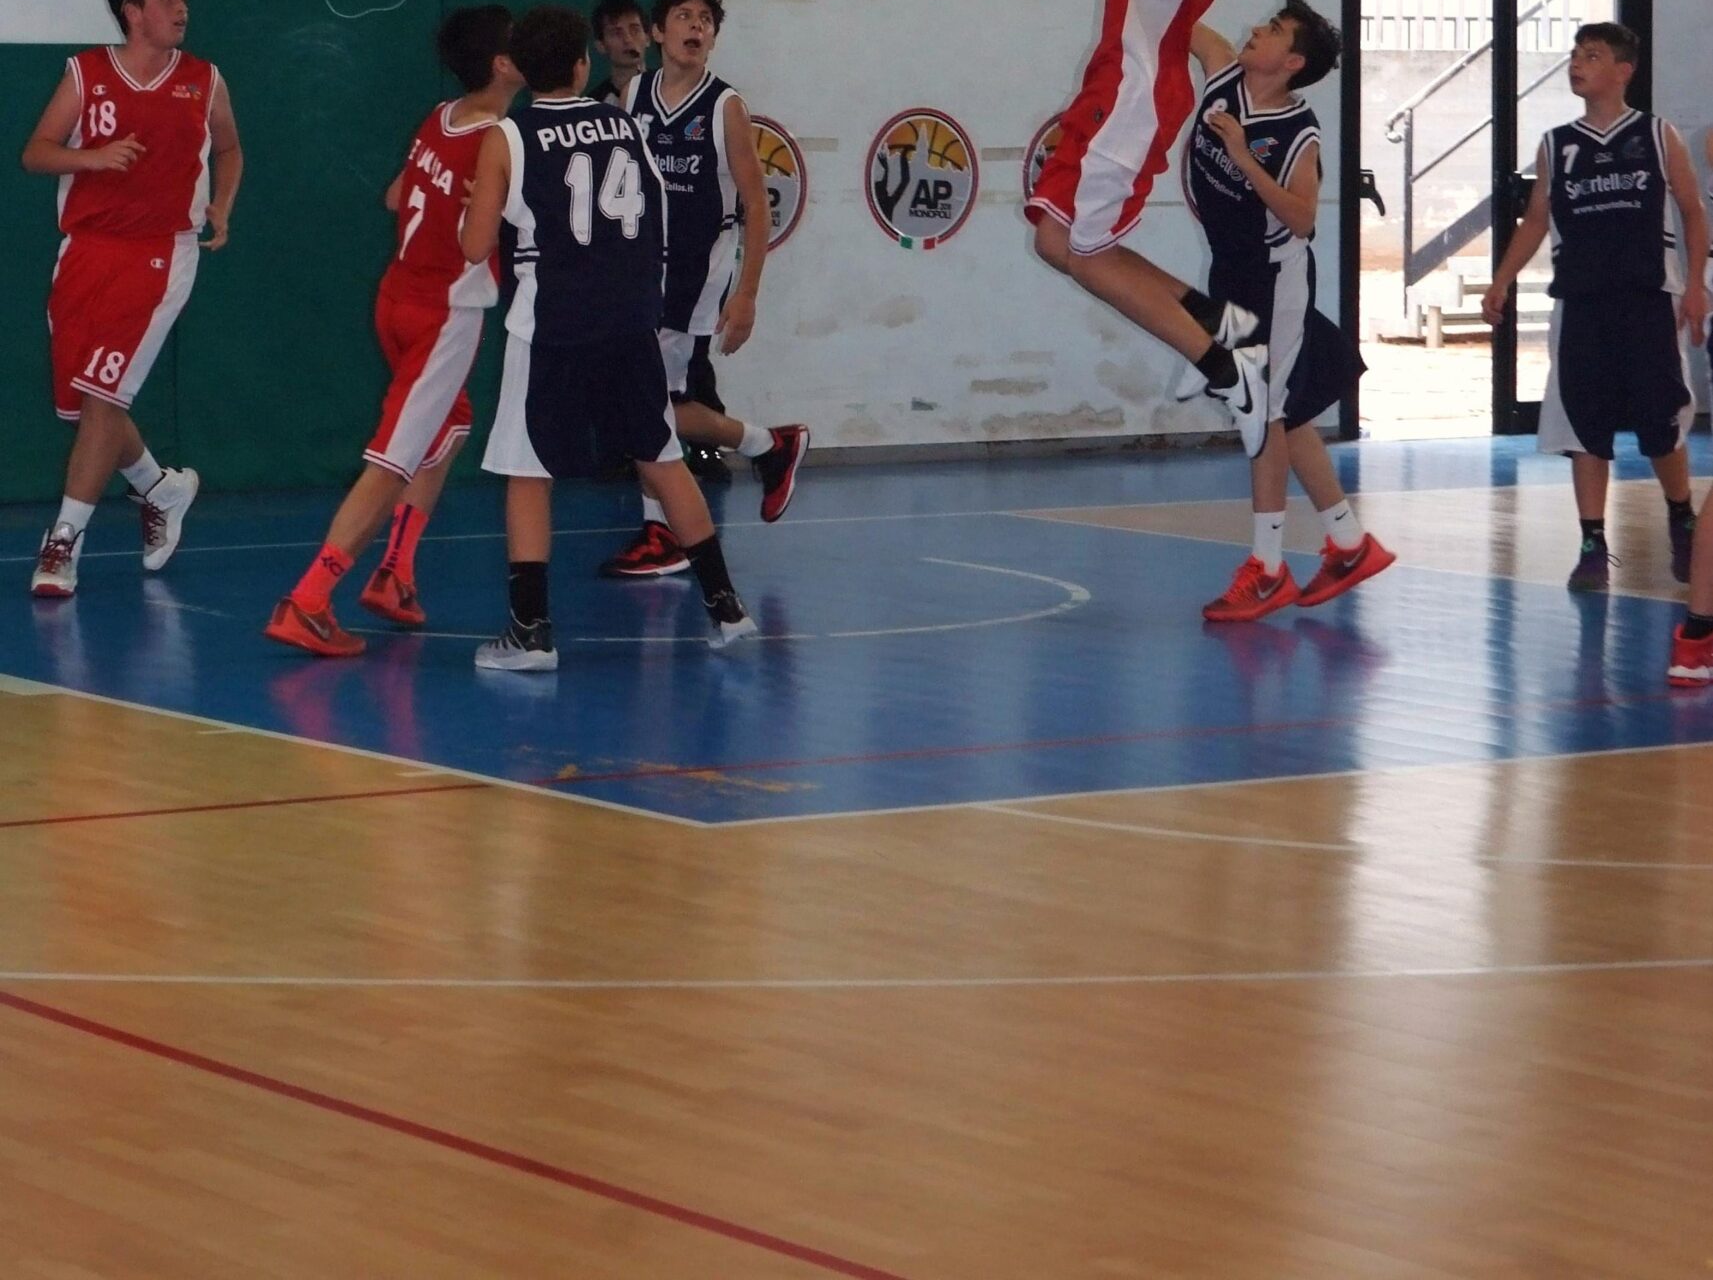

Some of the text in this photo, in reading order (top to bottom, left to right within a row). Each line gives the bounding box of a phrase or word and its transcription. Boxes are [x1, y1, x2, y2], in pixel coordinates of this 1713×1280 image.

[88, 100, 117, 137] 18
[536, 117, 635, 152] PUGLIA
[564, 146, 645, 246] 14
[910, 179, 952, 209] AP
[399, 185, 427, 261] 7
[83, 346, 126, 385] 18
